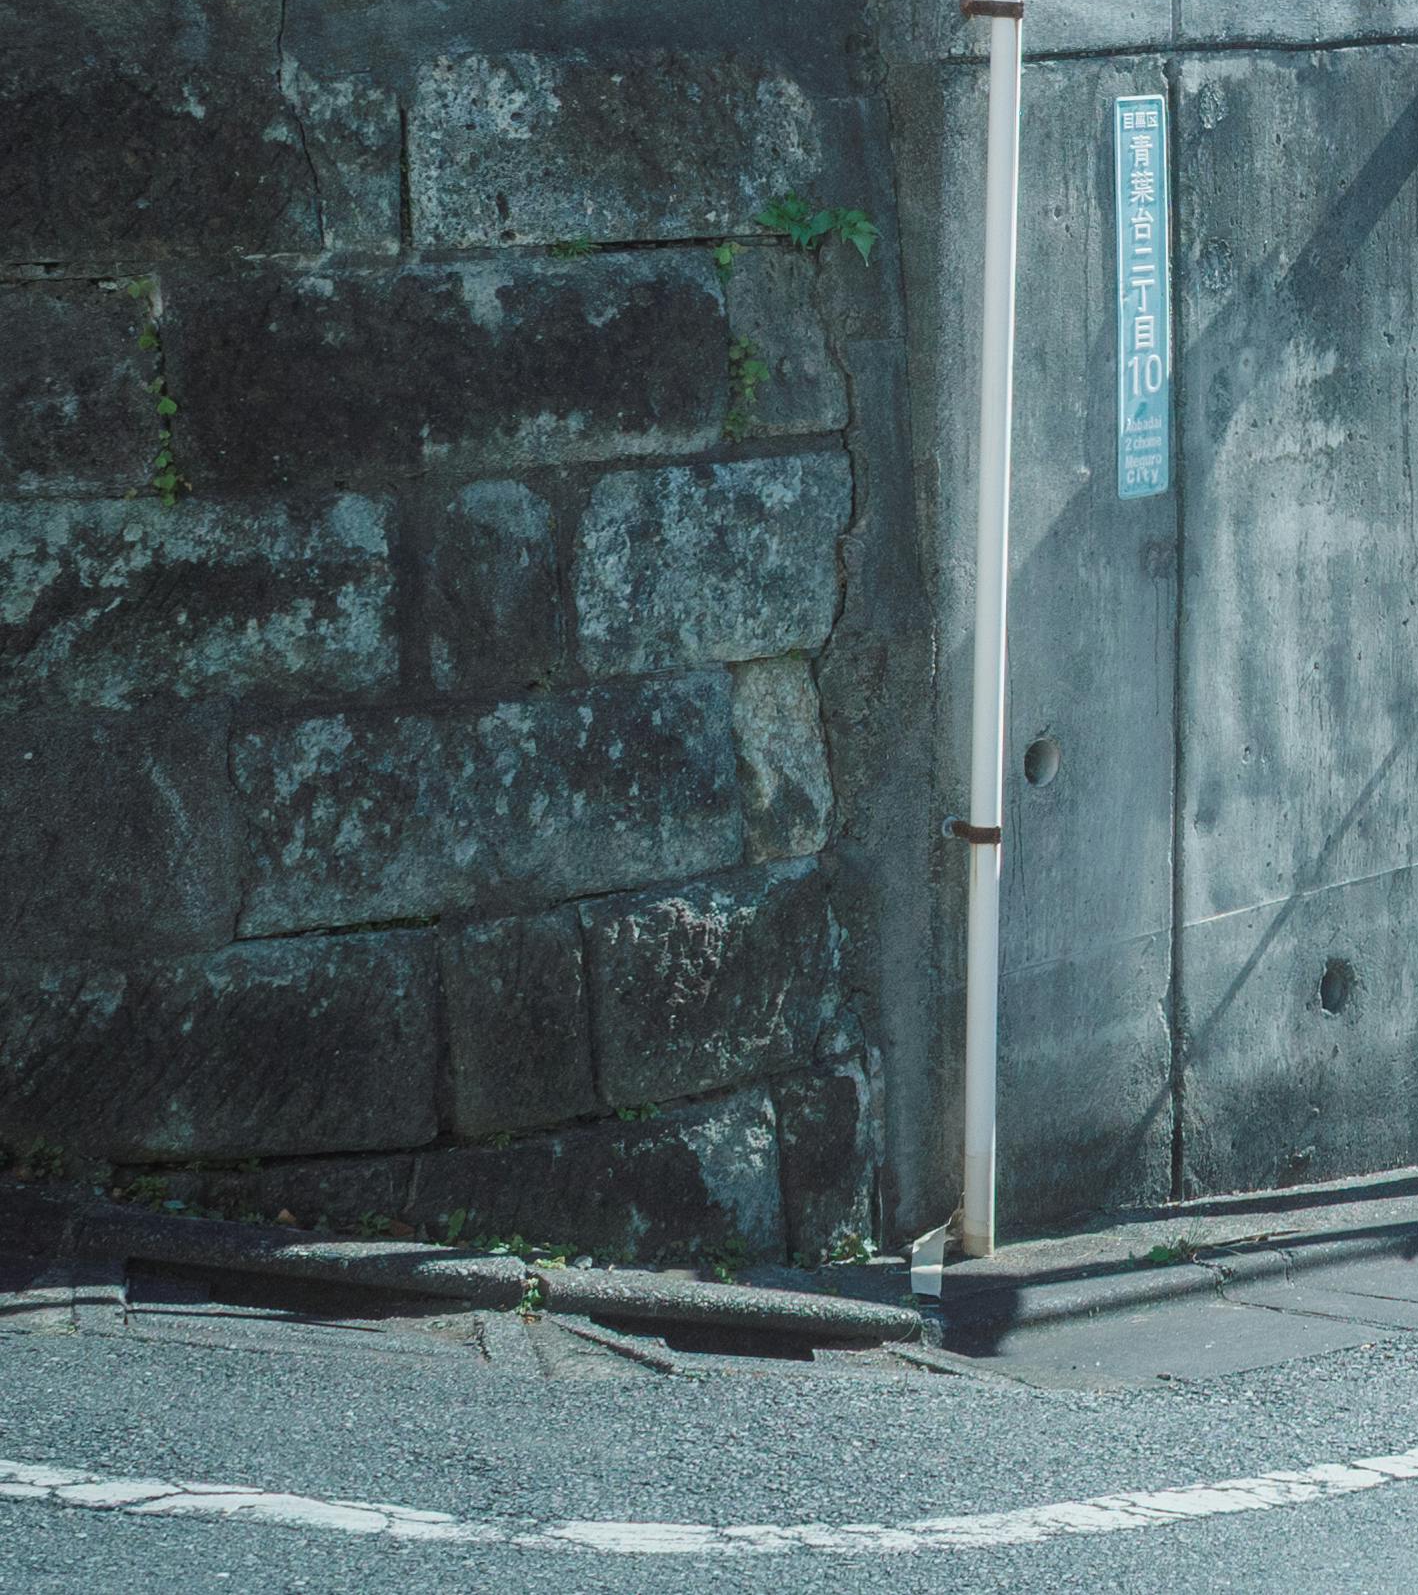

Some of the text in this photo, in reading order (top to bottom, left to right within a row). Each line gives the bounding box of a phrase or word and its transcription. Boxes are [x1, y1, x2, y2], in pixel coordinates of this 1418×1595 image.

[1123, 111, 1158, 129] 目黒区
[1125, 439, 1132, 451] 2
[1126, 455, 1161, 468] Meguro
[1127, 469, 1159, 484] City
